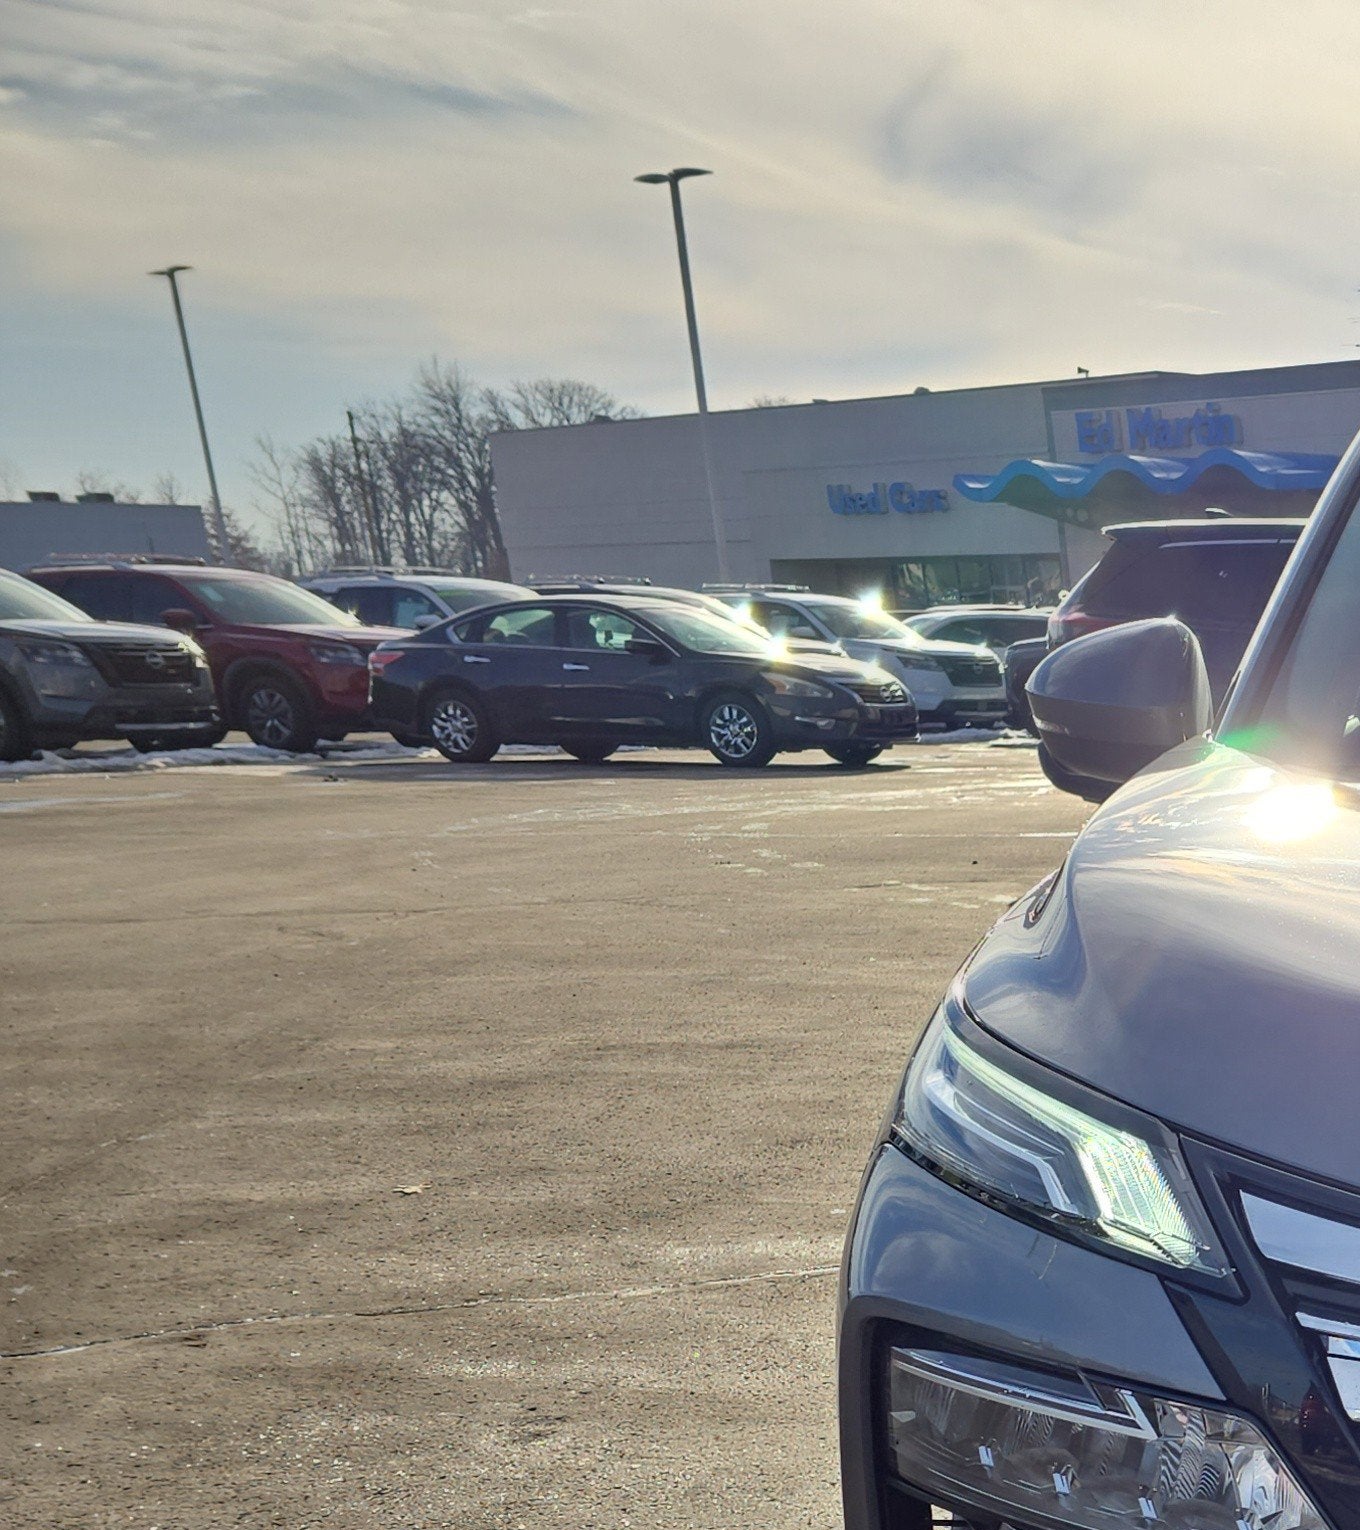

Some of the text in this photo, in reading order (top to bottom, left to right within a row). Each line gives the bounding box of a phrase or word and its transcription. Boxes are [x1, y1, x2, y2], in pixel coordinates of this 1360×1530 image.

[1075, 402, 1243, 454] Ed Martin
[826, 481, 951, 515] Used Cars
